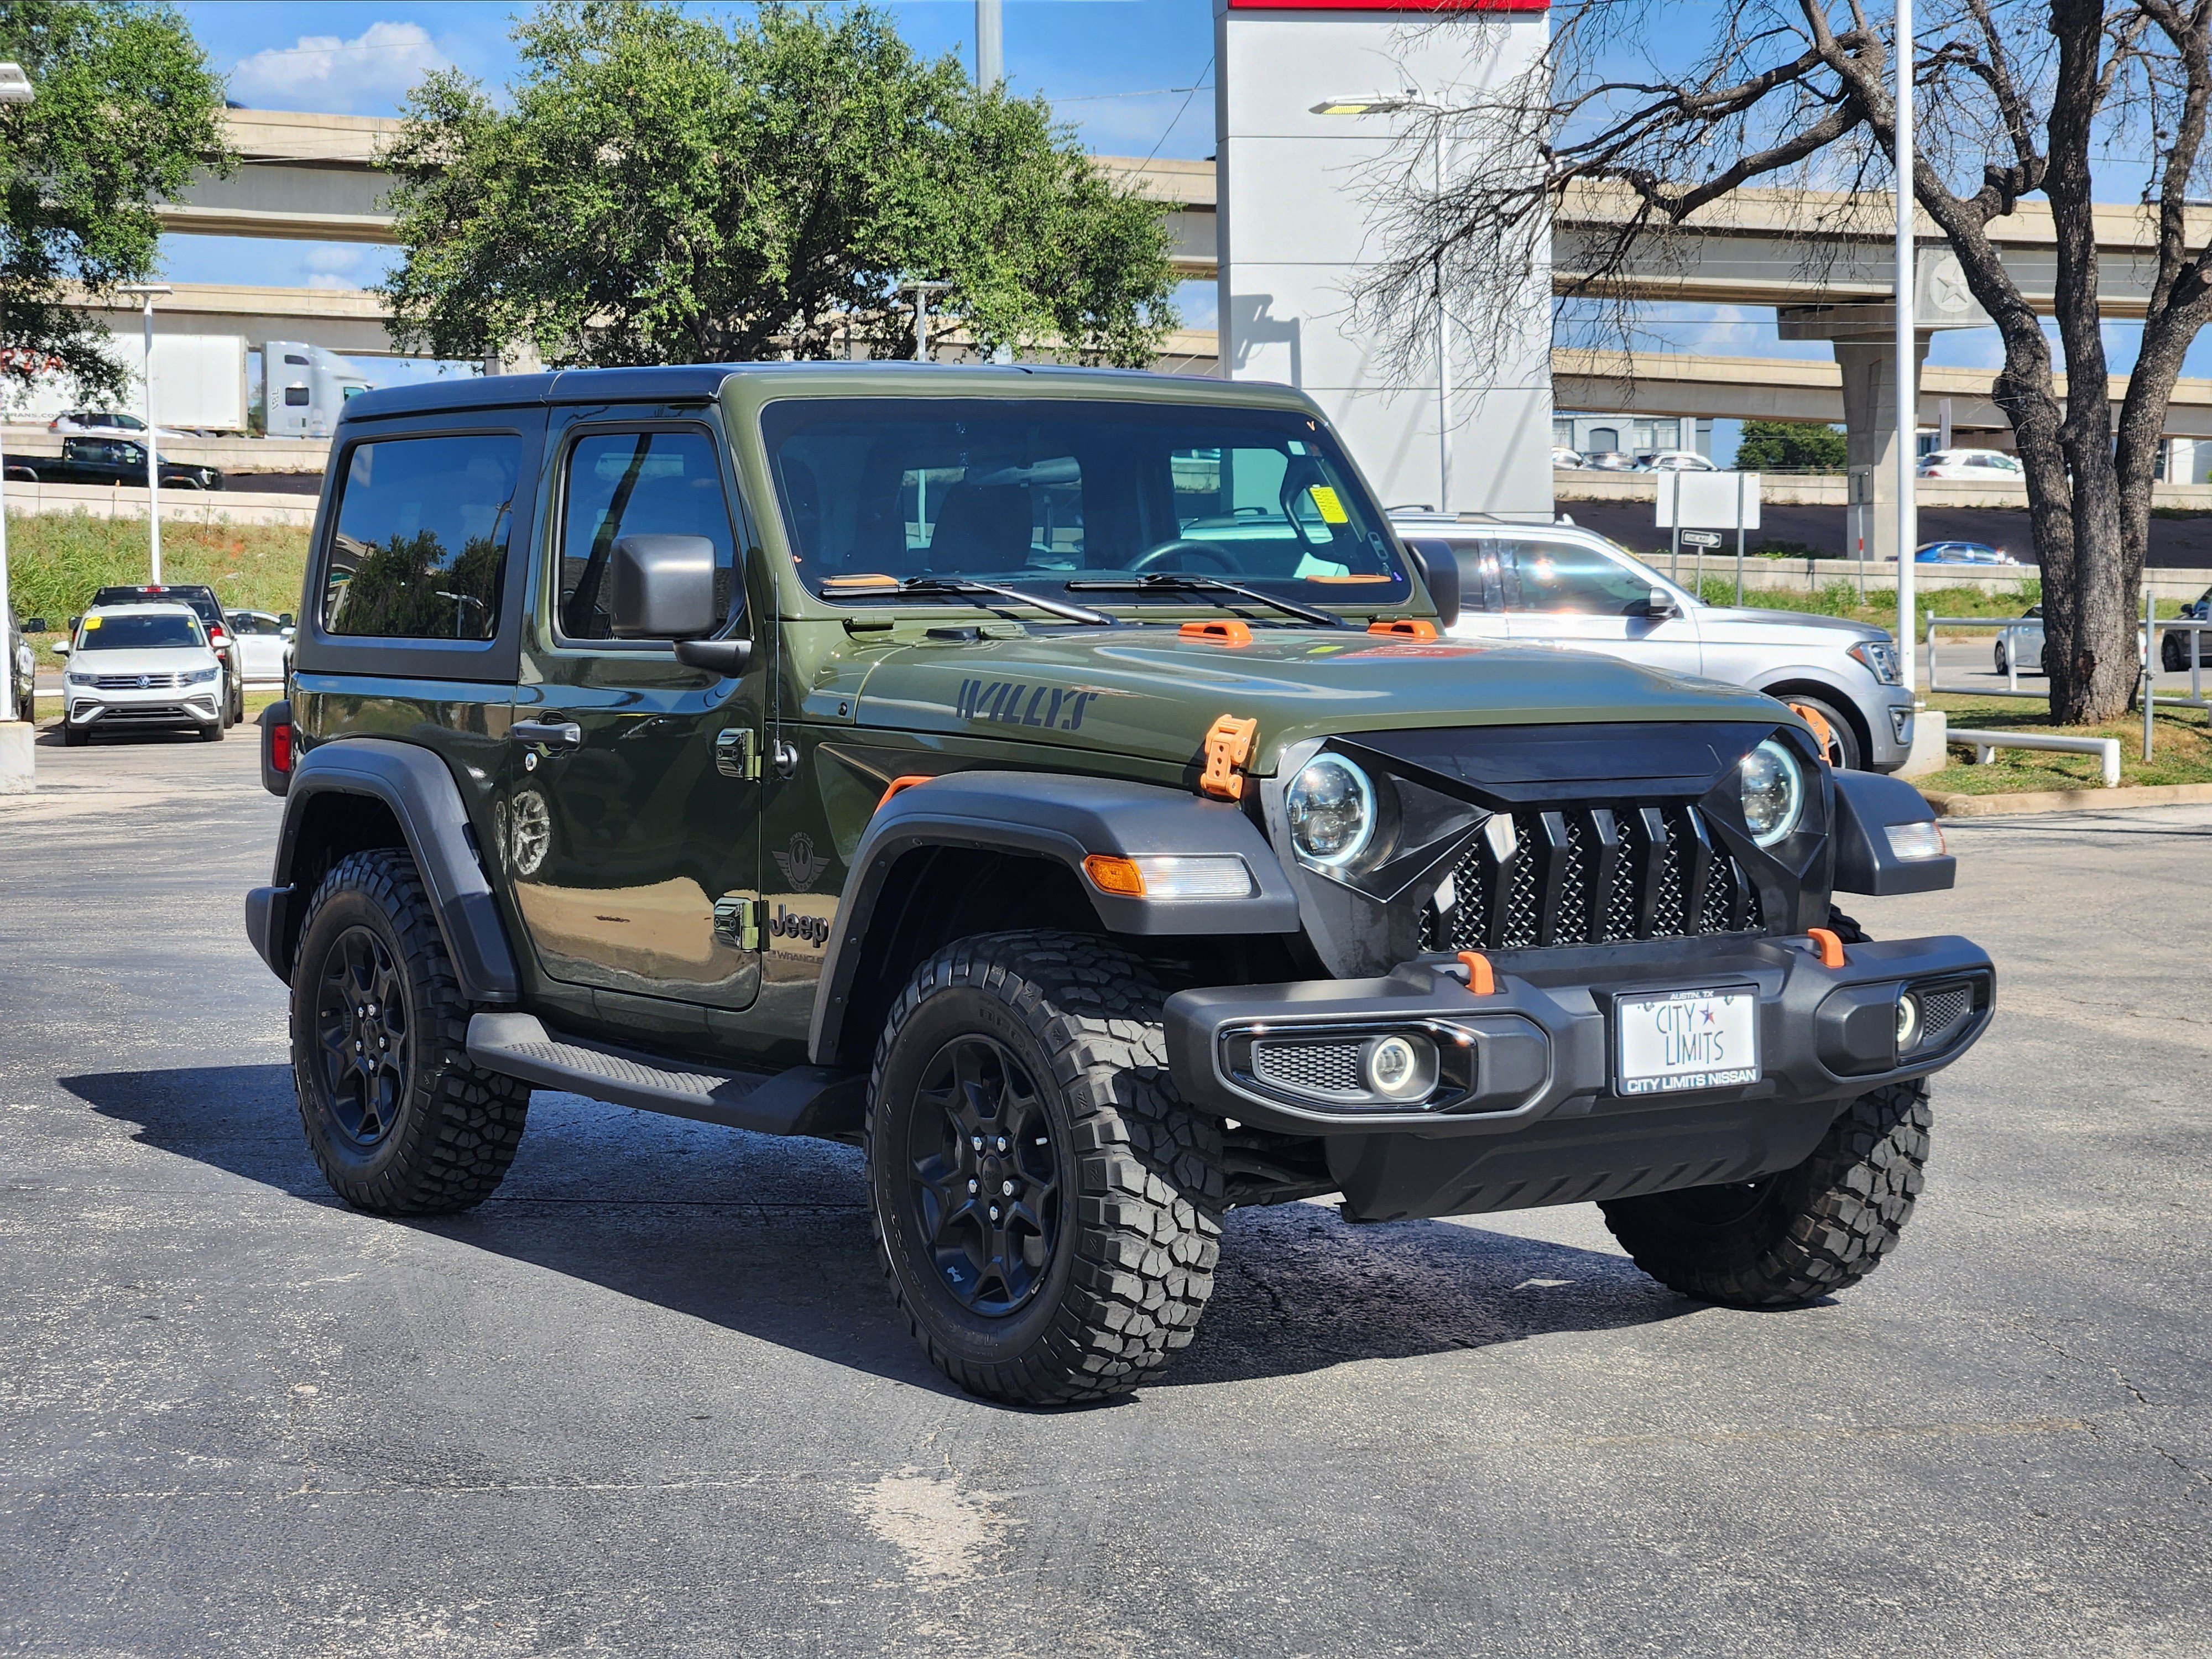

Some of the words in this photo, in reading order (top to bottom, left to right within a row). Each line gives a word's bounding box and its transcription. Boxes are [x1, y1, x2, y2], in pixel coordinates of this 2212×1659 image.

[956, 679, 1099, 731] WILLYS
[769, 904, 828, 948] Jeep
[777, 951, 824, 964] WRANGLE
[1657, 1003, 1695, 1036] CITY
[1666, 1031, 1724, 1066] LIMITS
[1627, 1078, 1660, 1092] CITY
[1662, 1074, 1706, 1090] LIMITS
[1709, 1069, 1756, 1084] NISSAN
